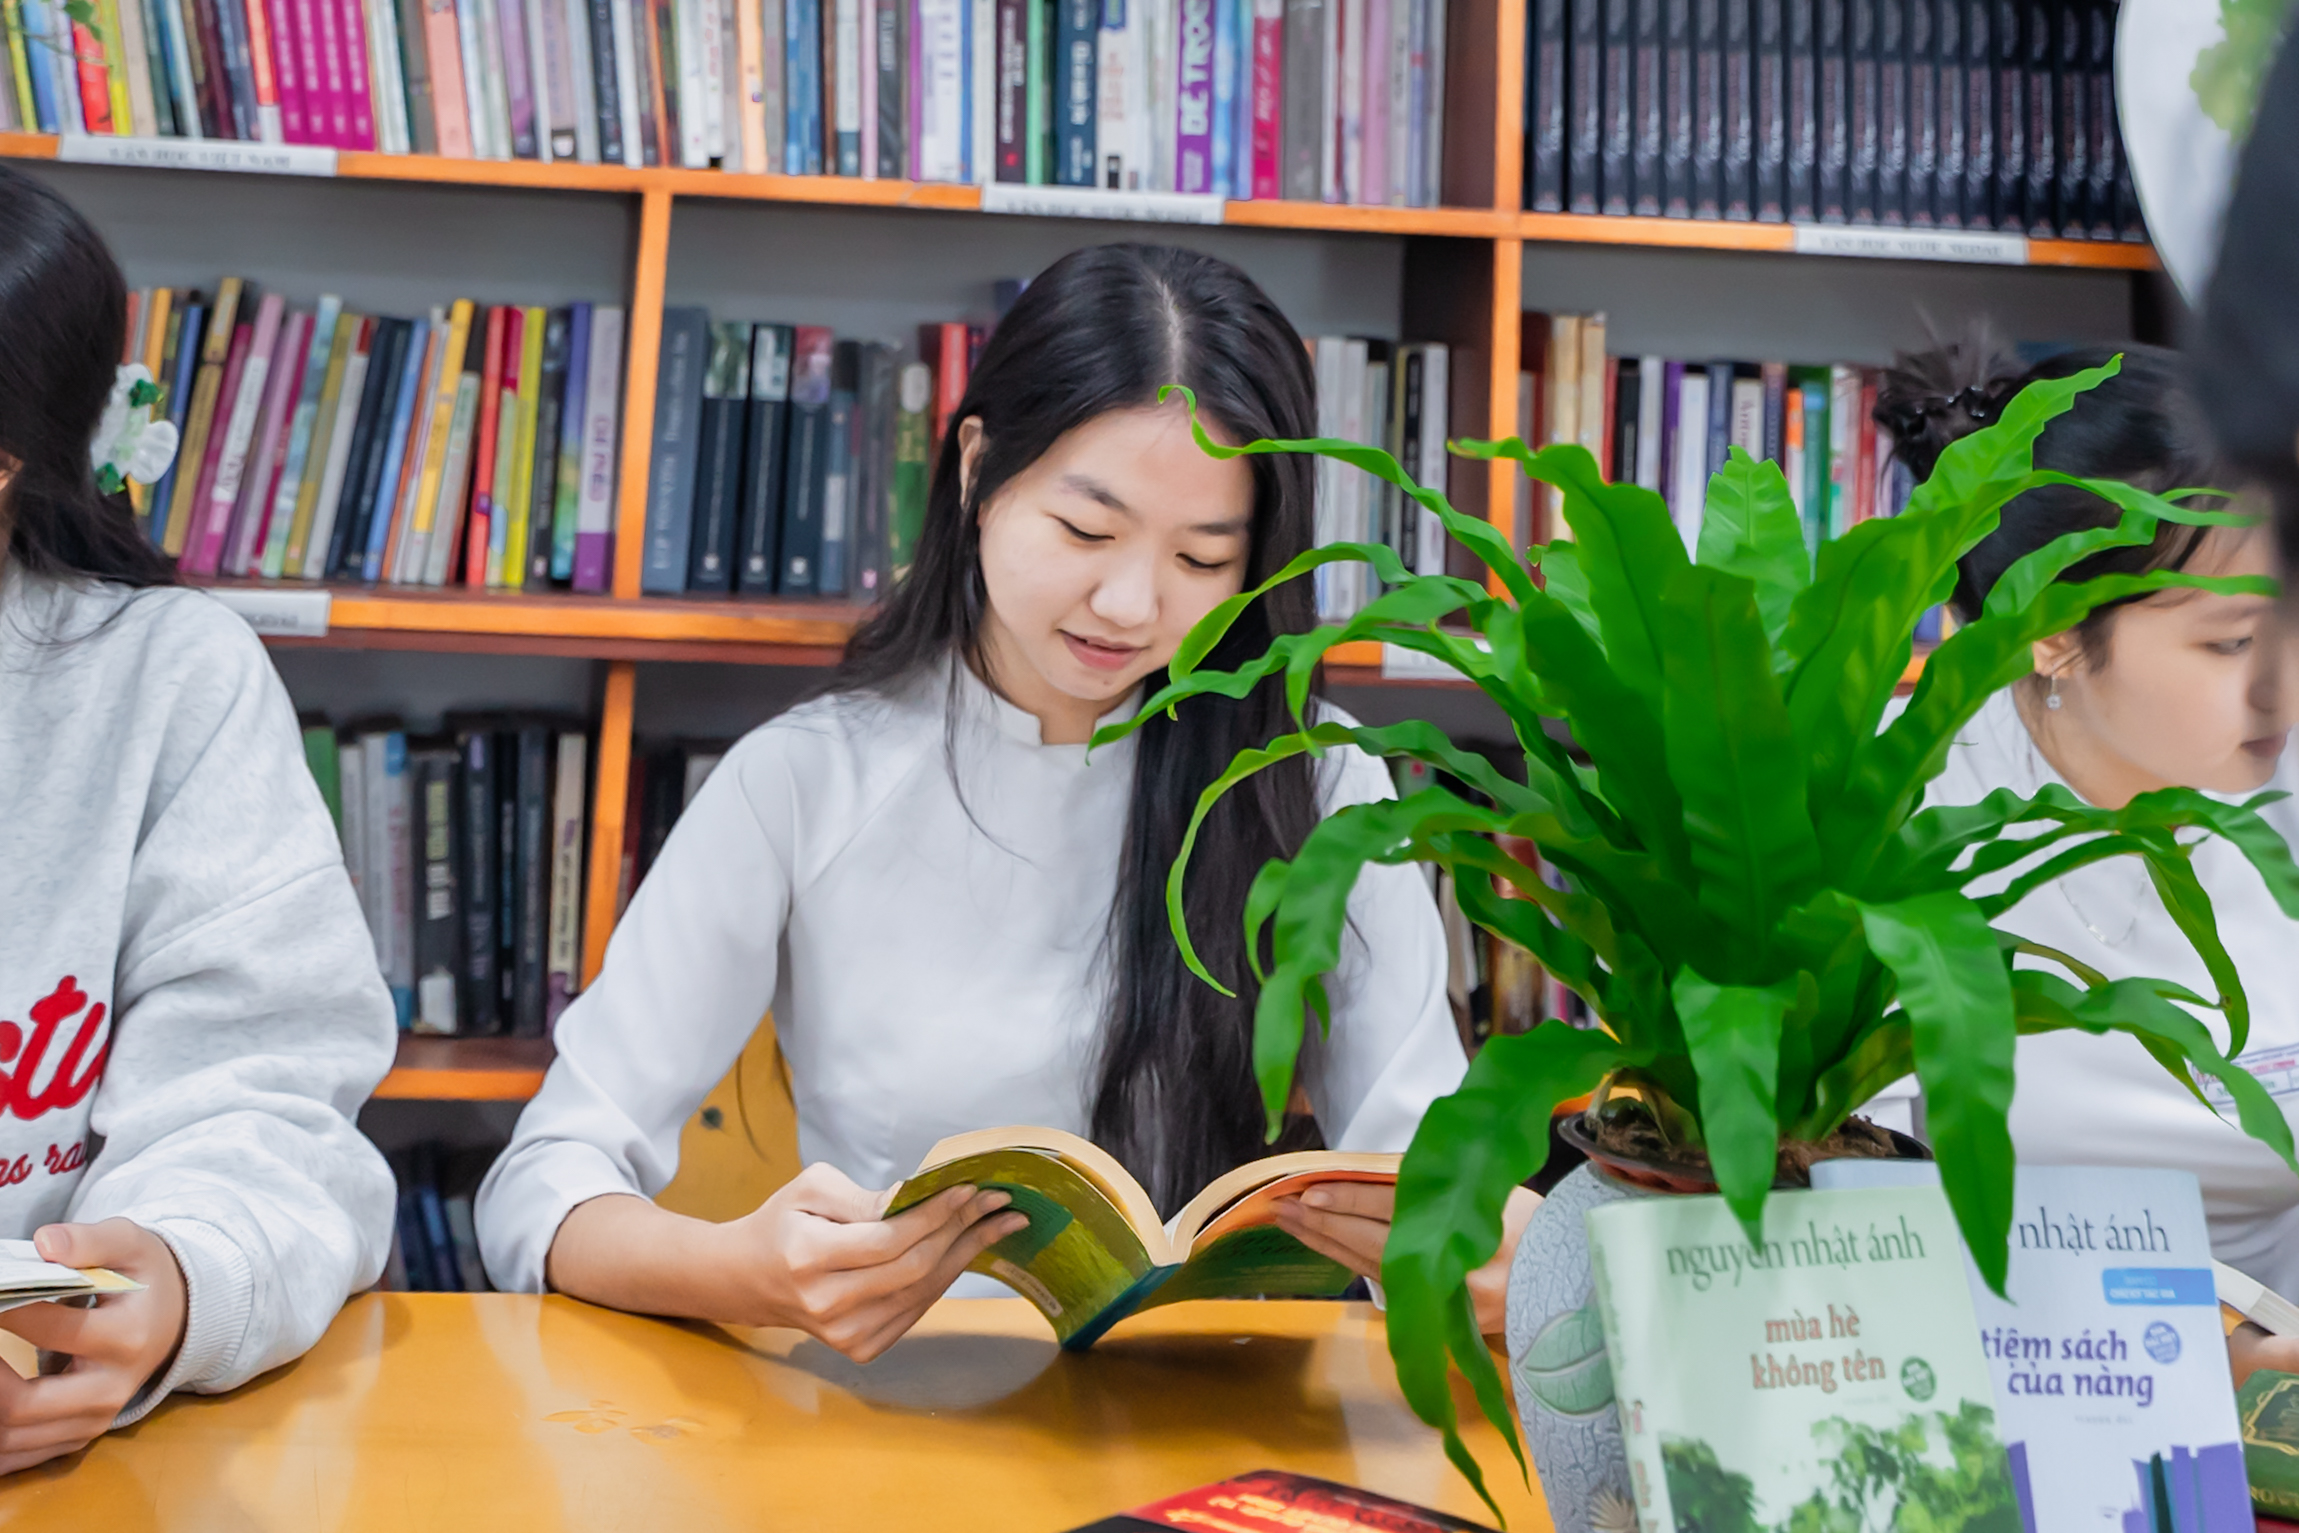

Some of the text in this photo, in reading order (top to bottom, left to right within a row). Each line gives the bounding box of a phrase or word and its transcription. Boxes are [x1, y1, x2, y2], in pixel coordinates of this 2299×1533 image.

[1791, 1219, 1862, 1271] nhật
[1868, 1214, 1927, 1262] ánh
[2018, 1206, 2172, 1257] nhật ánh
[1765, 1303, 1861, 1343] mùa hè
[1981, 1326, 2052, 1369] tiệm
[2061, 1327, 2128, 1361] sách
[1750, 1352, 1838, 1394] không
[1842, 1348, 1887, 1382] tên
[2008, 1361, 2155, 1407] của nàng
